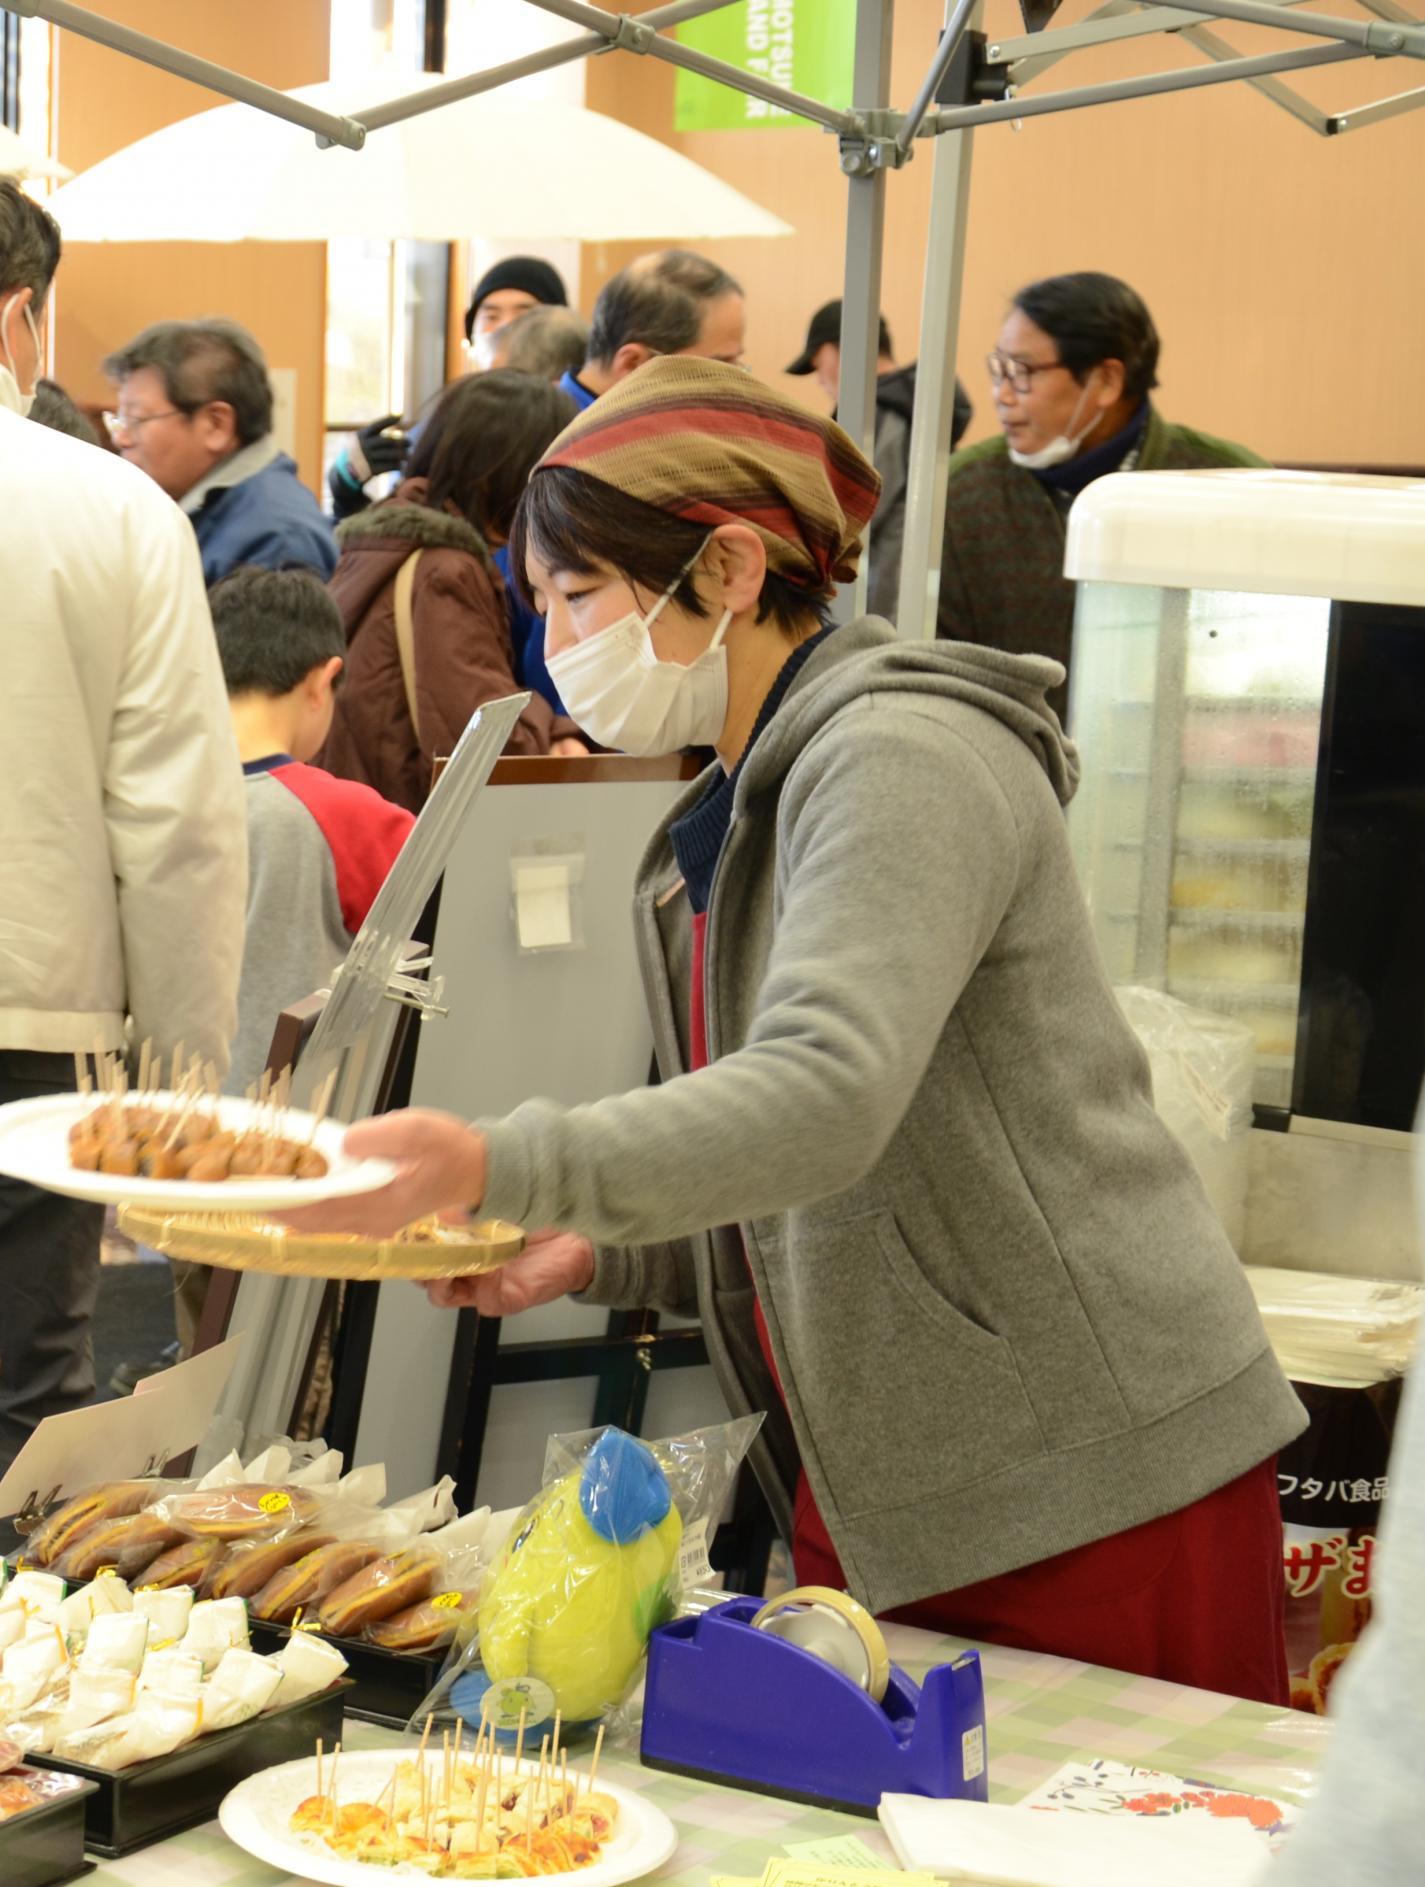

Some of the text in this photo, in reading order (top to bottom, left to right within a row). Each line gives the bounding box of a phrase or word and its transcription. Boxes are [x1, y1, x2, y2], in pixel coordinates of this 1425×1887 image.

[1277, 1474, 1390, 1502] フタバ食品
